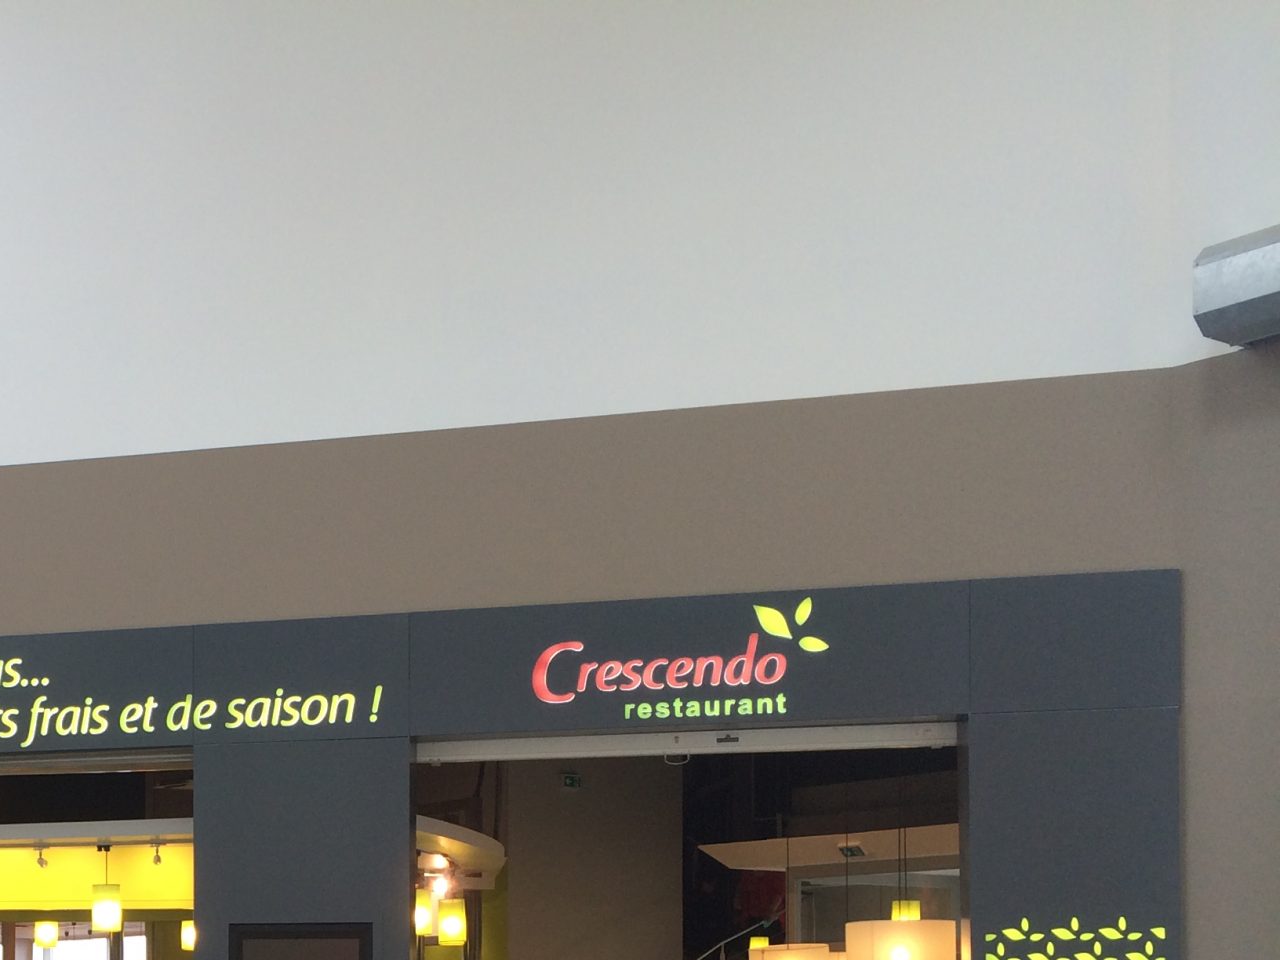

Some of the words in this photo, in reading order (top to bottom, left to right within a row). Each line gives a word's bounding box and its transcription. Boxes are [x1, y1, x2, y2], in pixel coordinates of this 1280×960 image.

[531, 632, 788, 705] Crescendo
[19, 695, 110, 749] frais
[119, 696, 159, 734] et
[165, 693, 218, 732] de
[224, 687, 357, 729] saison
[368, 684, 384, 723] !
[624, 692, 787, 720] restaurant
